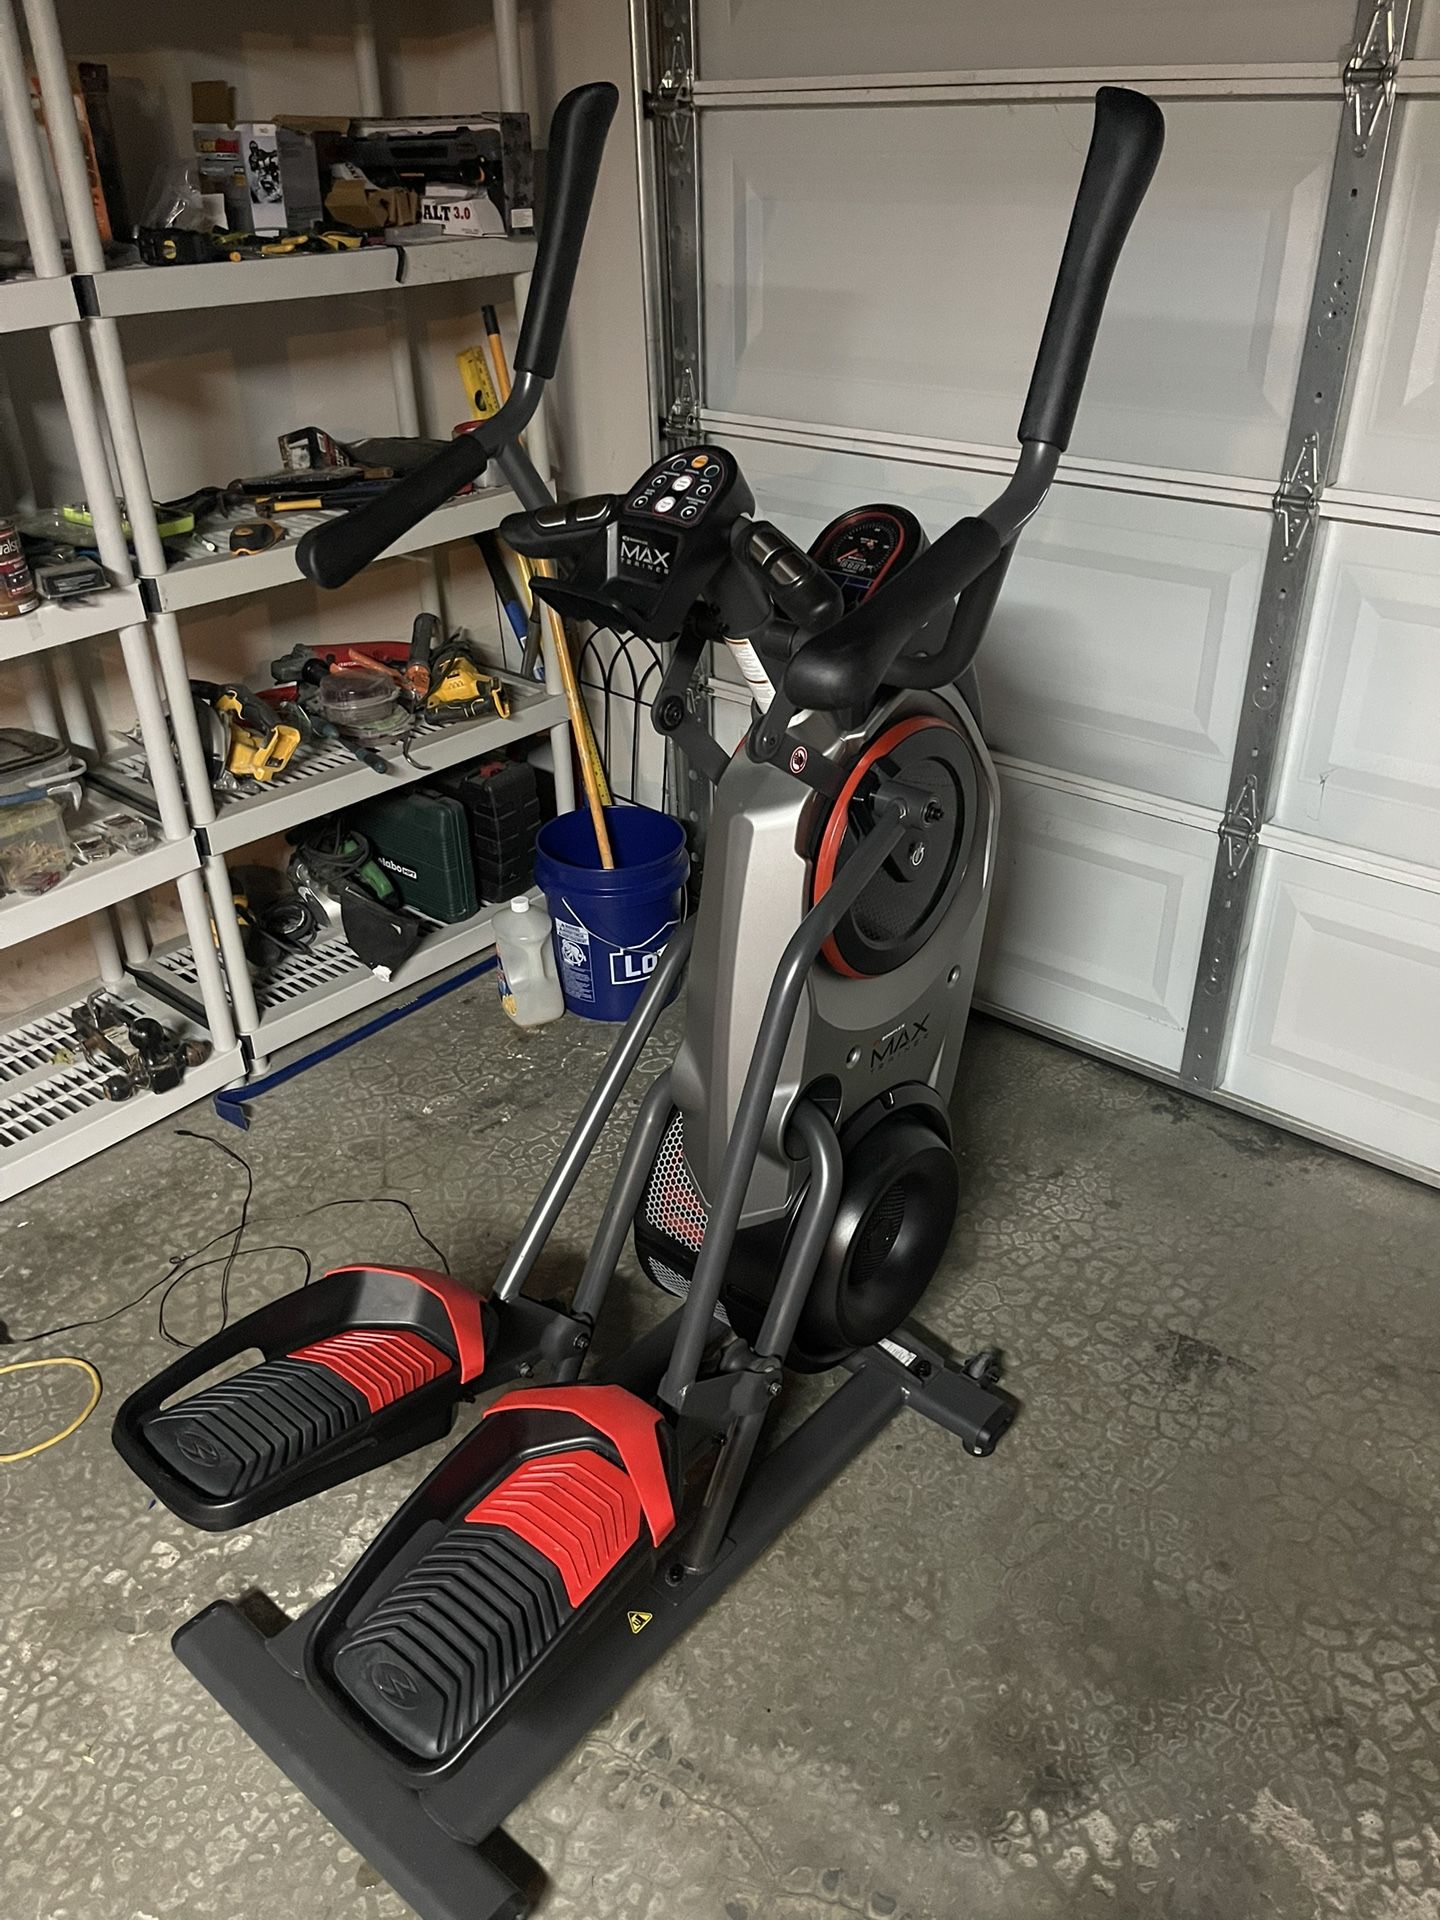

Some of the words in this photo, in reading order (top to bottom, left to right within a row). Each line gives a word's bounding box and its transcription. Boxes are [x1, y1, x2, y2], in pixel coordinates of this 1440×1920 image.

[423, 204, 451, 221] ALT
[453, 206, 471, 220] 3.0
[620, 541, 671, 569] MAX
[620, 557, 670, 575] TRAINER
[870, 1013, 930, 1069] MAX
